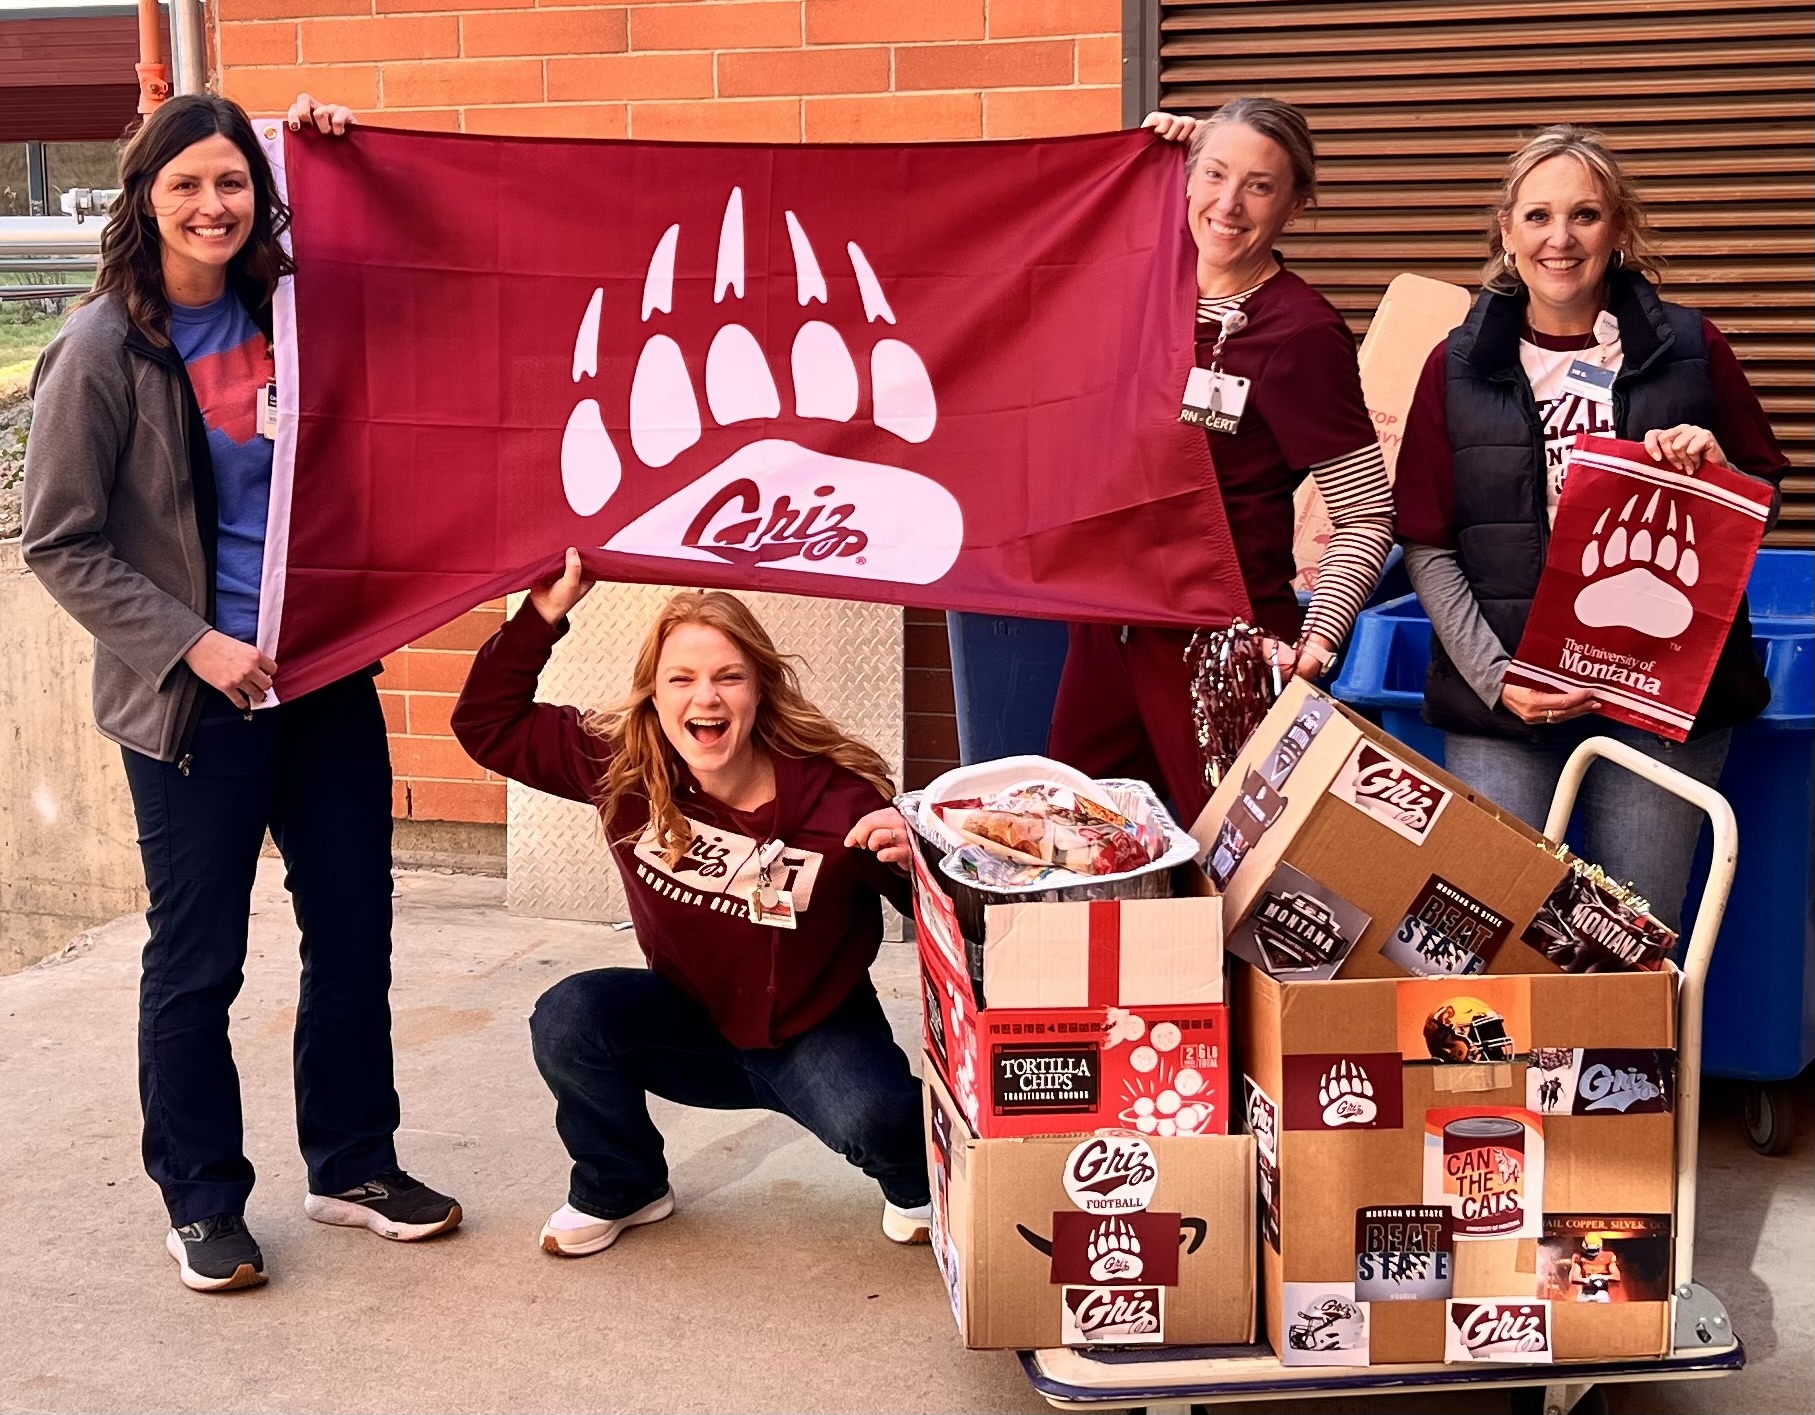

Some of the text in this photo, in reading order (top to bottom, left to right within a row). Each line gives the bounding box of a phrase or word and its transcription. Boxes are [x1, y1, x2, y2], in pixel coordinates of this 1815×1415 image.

[1180, 409, 1199, 423] RN
[681, 478, 868, 562] Griz
[1565, 637, 1656, 672] The University of
[1559, 648, 1662, 696] Montana
[1355, 760, 1433, 829] Griz
[637, 863, 750, 918] MONTANA GRIZ
[1436, 882, 1470, 907] MONTANA
[1481, 910, 1502, 928] STATE
[1264, 903, 1334, 953] MONTANA
[1417, 894, 1494, 954] BEAT
[1569, 903, 1647, 964] MONTANA
[1001, 1058, 1091, 1078] TORTILLA
[1186, 1047, 1194, 1060] 2
[1003, 1090, 1089, 1101] TRADITIONAL ROUNDS
[1019, 1073, 1072, 1091] CHIPS
[1579, 1063, 1659, 1103] Griz
[1337, 1100, 1363, 1116] Griz
[1073, 1139, 1155, 1188] Griz
[1447, 1148, 1490, 1176] CAN
[1456, 1171, 1493, 1196] THE
[1086, 1198, 1143, 1209] FOOTBALL
[1366, 1210, 1403, 1218] MONTANA
[1462, 1189, 1518, 1220] CATS
[1366, 1223, 1442, 1253] BEAT
[1104, 1256, 1130, 1272] Griz
[1075, 1289, 1158, 1335] Griz
[1462, 1303, 1545, 1352] Griz
